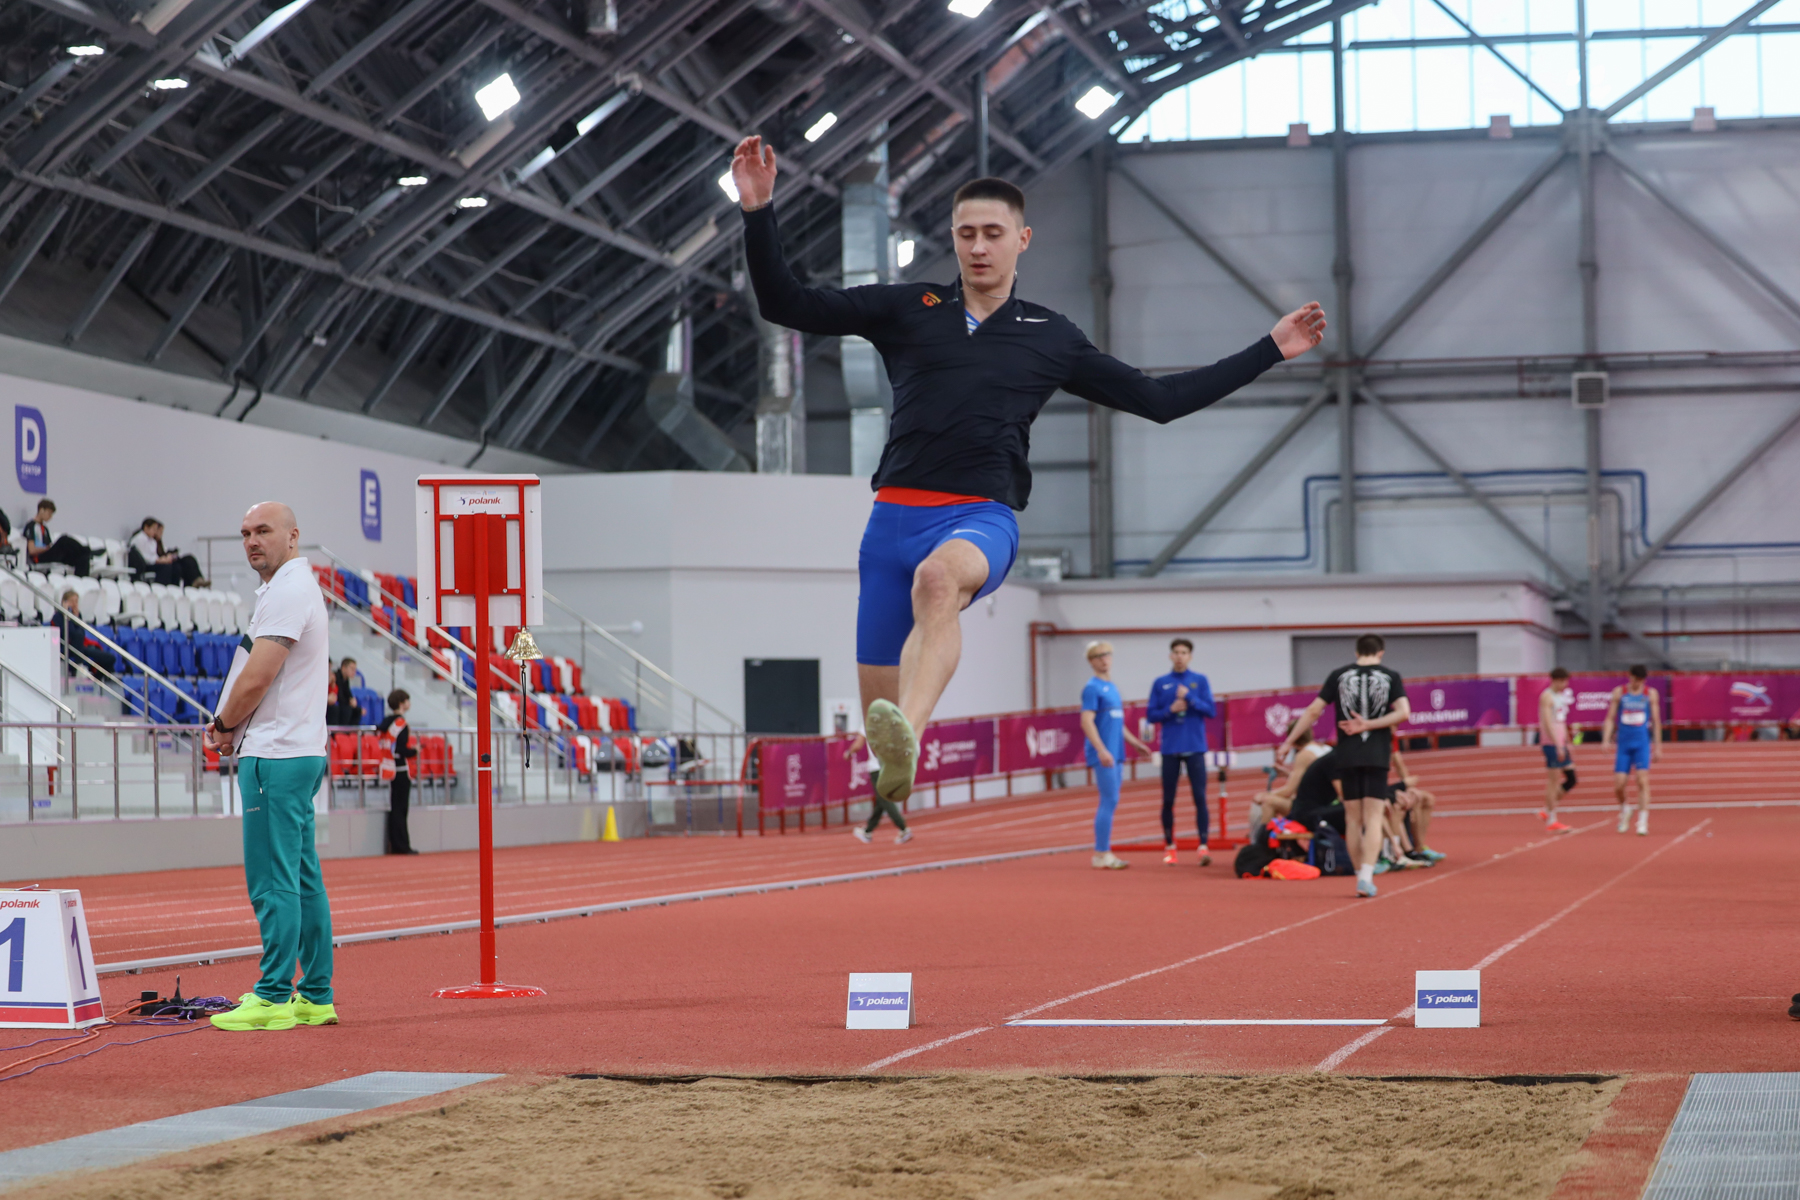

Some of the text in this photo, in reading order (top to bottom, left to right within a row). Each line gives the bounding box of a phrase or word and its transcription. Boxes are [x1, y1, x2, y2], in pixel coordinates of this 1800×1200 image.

[22, 417, 40, 463] D
[365, 479, 377, 516] E
[469, 497, 501, 506] polanik
[0, 899, 40, 909] polanik
[0, 918, 25, 992] 1
[71, 916, 87, 990] 1
[866, 997, 904, 1007] polanik
[1435, 995, 1474, 1005] polanik
